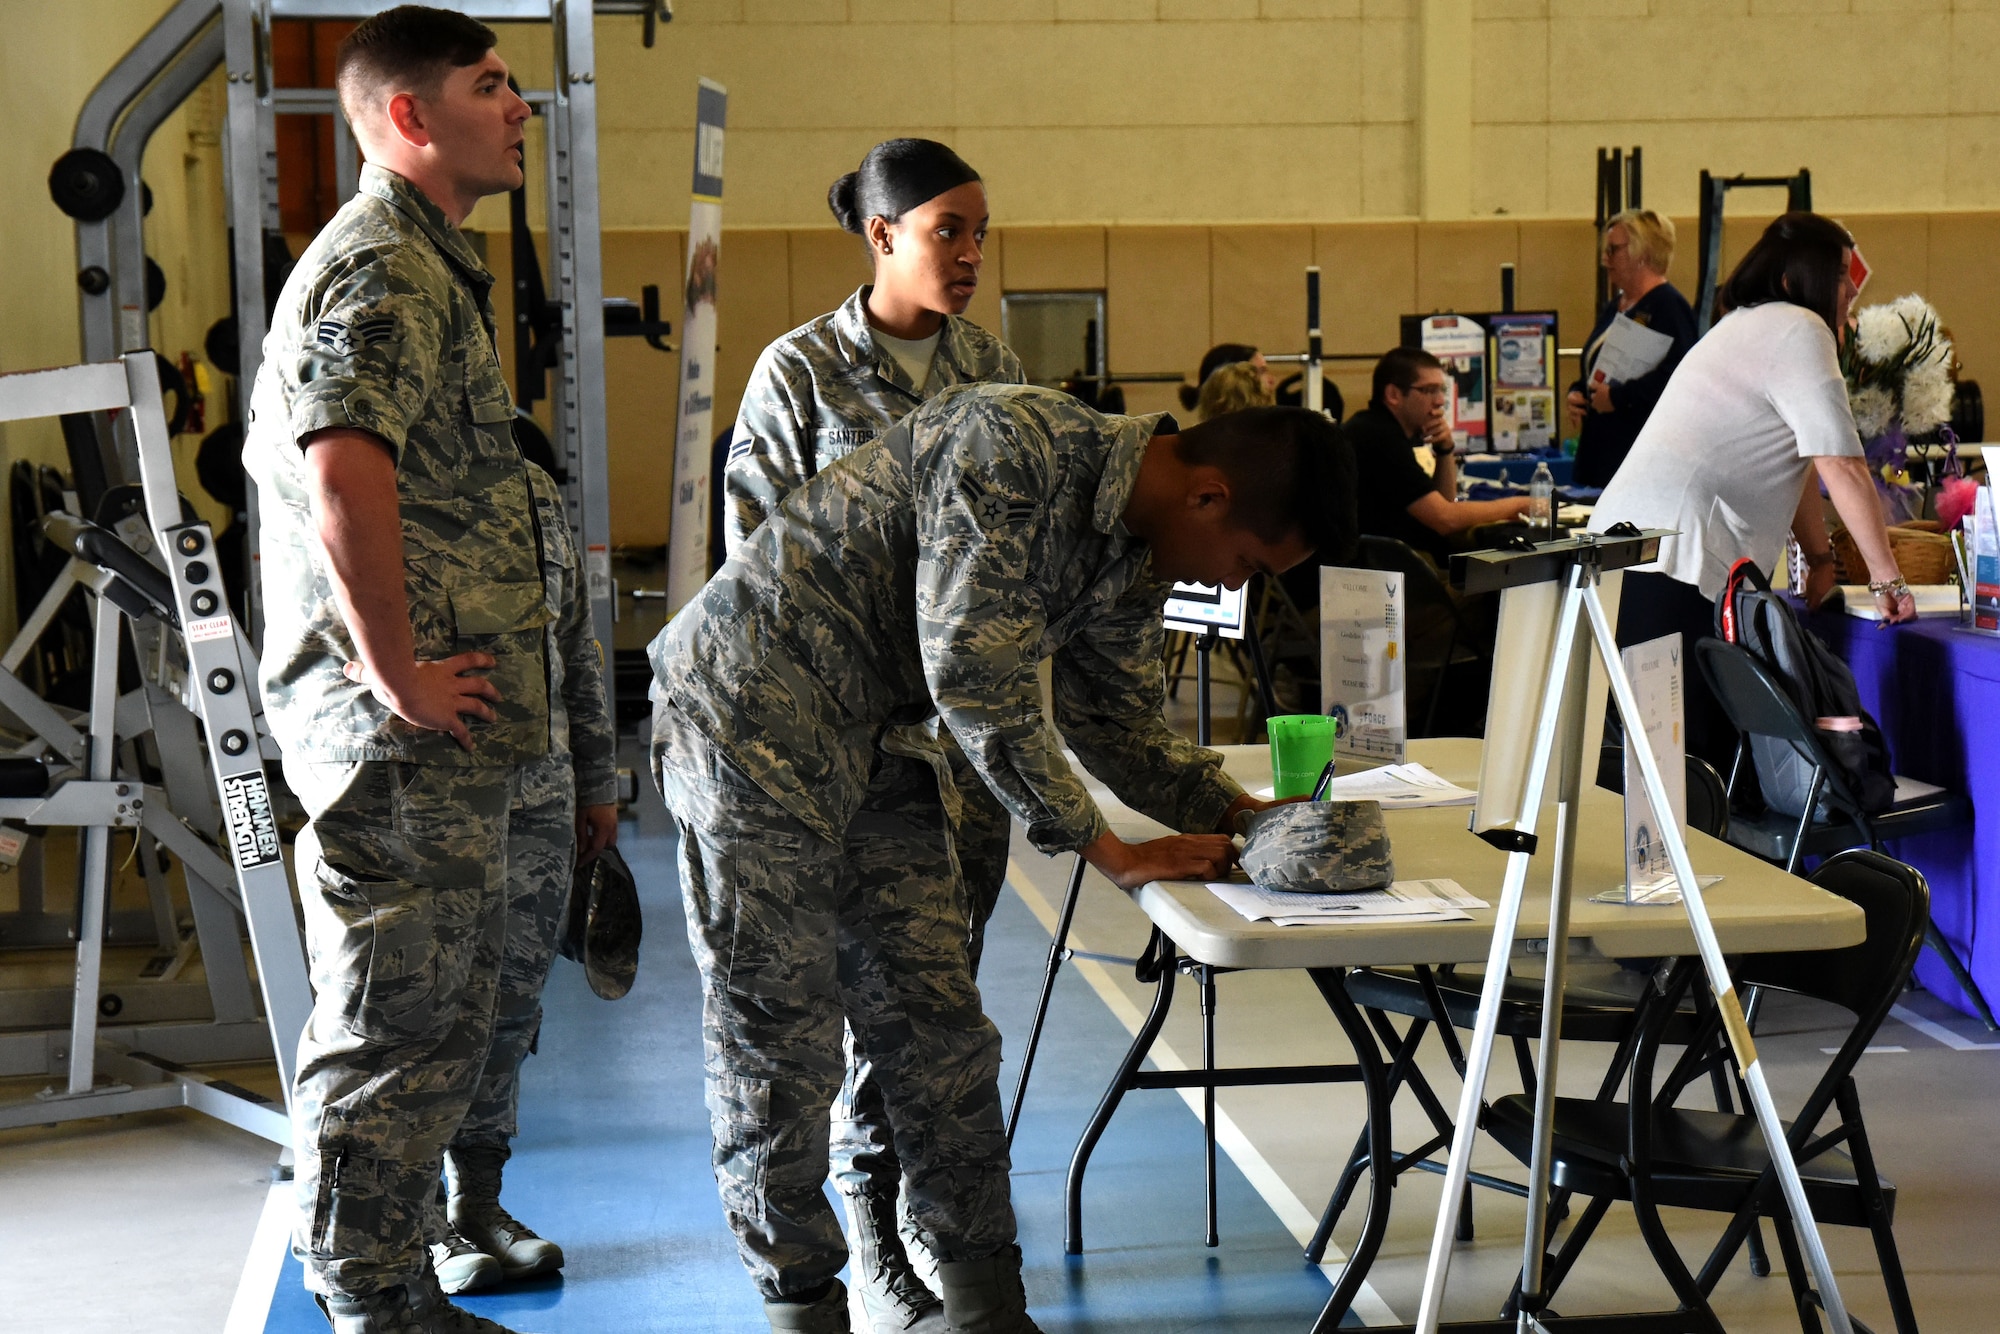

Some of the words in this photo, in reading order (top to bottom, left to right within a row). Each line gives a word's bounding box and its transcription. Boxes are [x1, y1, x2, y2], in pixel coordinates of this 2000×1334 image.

[828, 428, 874, 445] SANTOS
[192, 624, 207, 632] STAY
[209, 620, 228, 629] CLEAR
[1364, 712, 1386, 725] FORCE
[224, 778, 261, 866] STRENGTH
[243, 777, 278, 858] HAMMER
